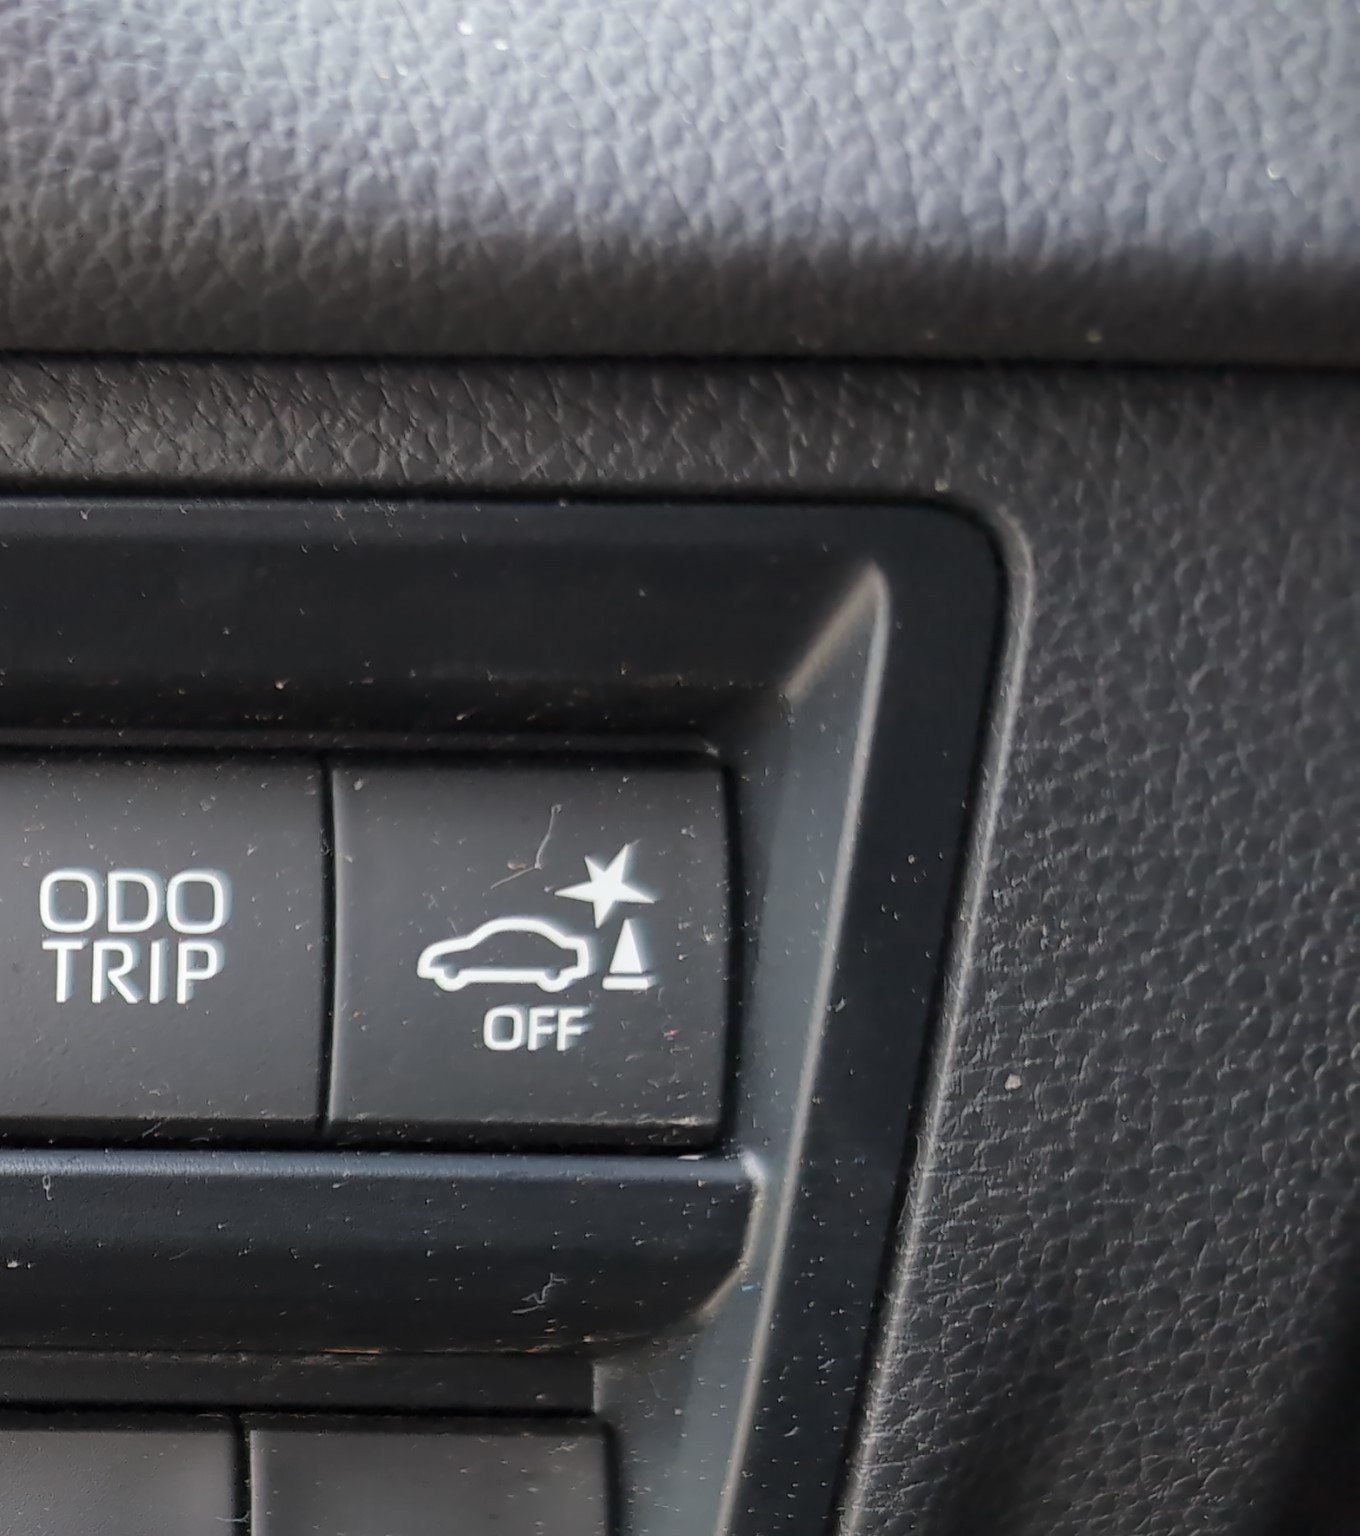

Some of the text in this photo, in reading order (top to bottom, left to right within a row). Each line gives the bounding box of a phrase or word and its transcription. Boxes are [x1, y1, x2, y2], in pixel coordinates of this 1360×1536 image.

[38, 868, 227, 935] ODO
[41, 938, 221, 1004] TRIP
[482, 1005, 588, 1051] OFF
